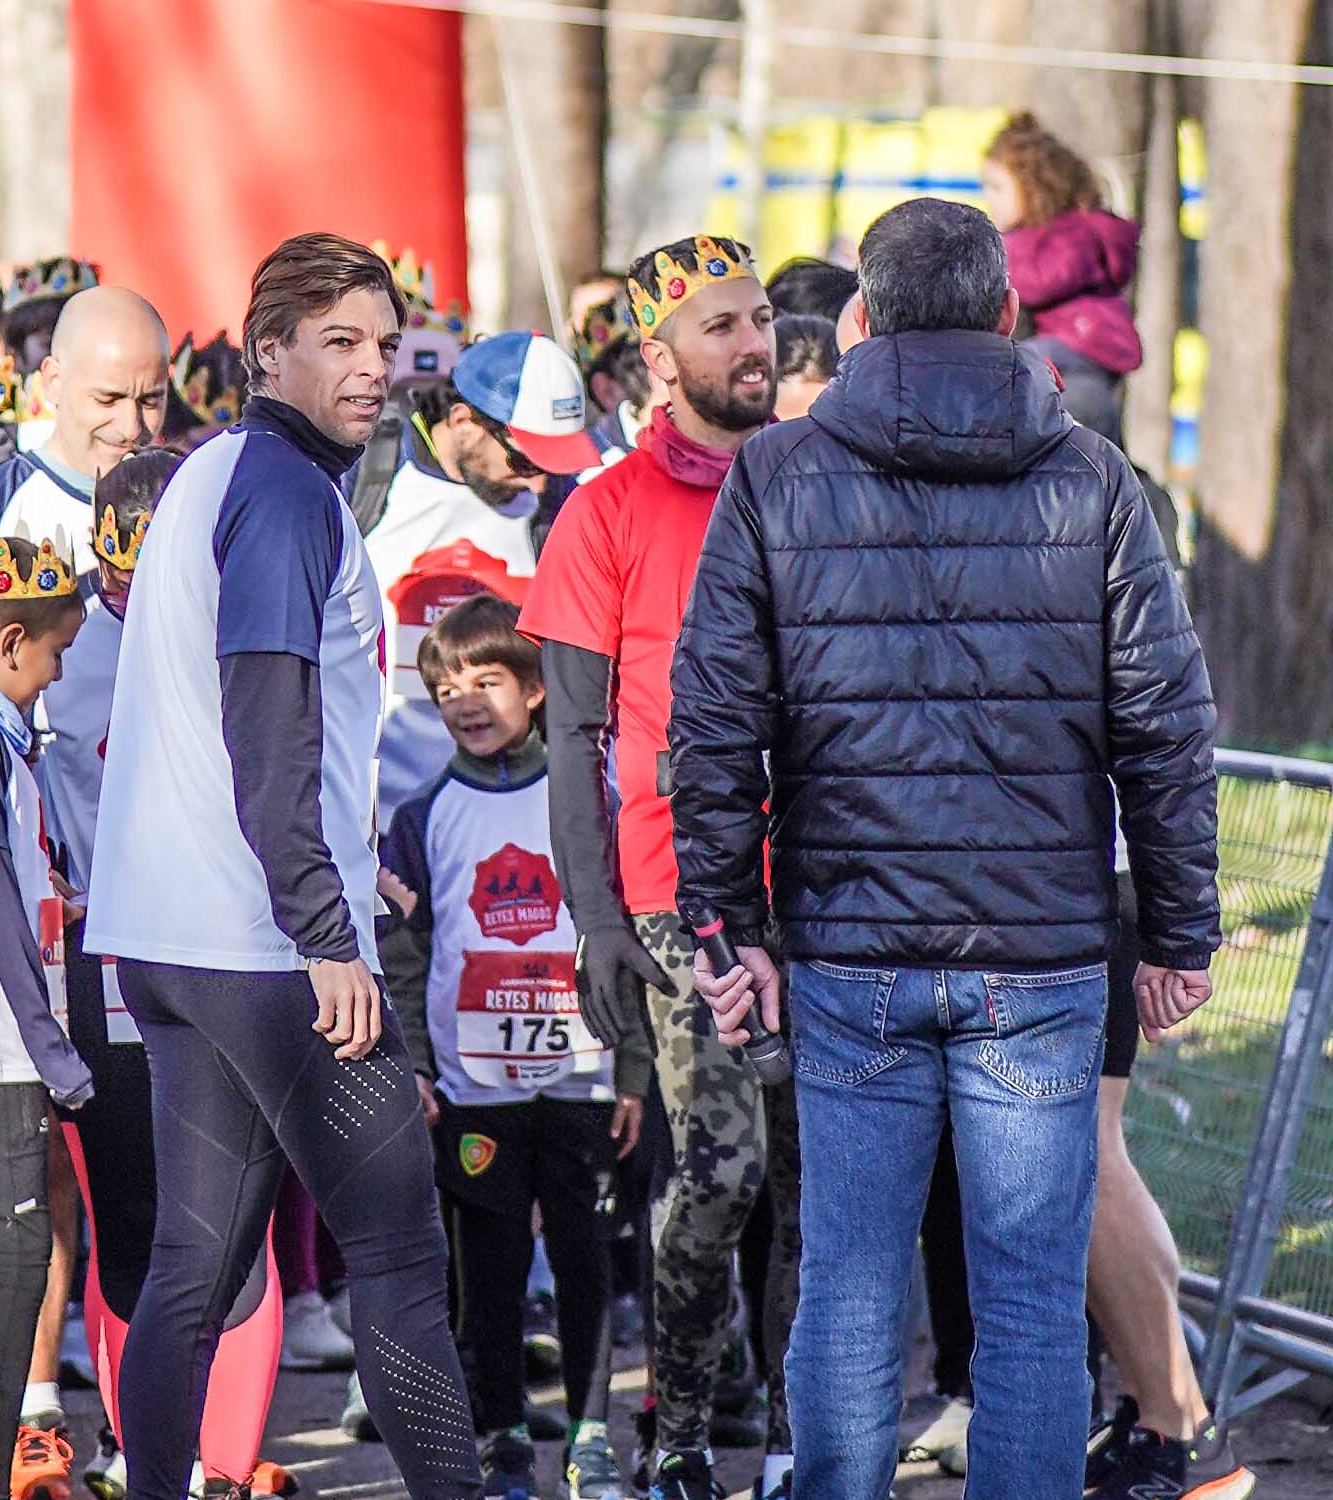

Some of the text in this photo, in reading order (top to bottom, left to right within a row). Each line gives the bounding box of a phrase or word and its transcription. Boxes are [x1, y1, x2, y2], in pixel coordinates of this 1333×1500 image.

[484, 905, 552, 926] REYES MAGOS
[485, 989, 579, 1010] REYES MAGOS
[498, 1016, 569, 1051] 175
